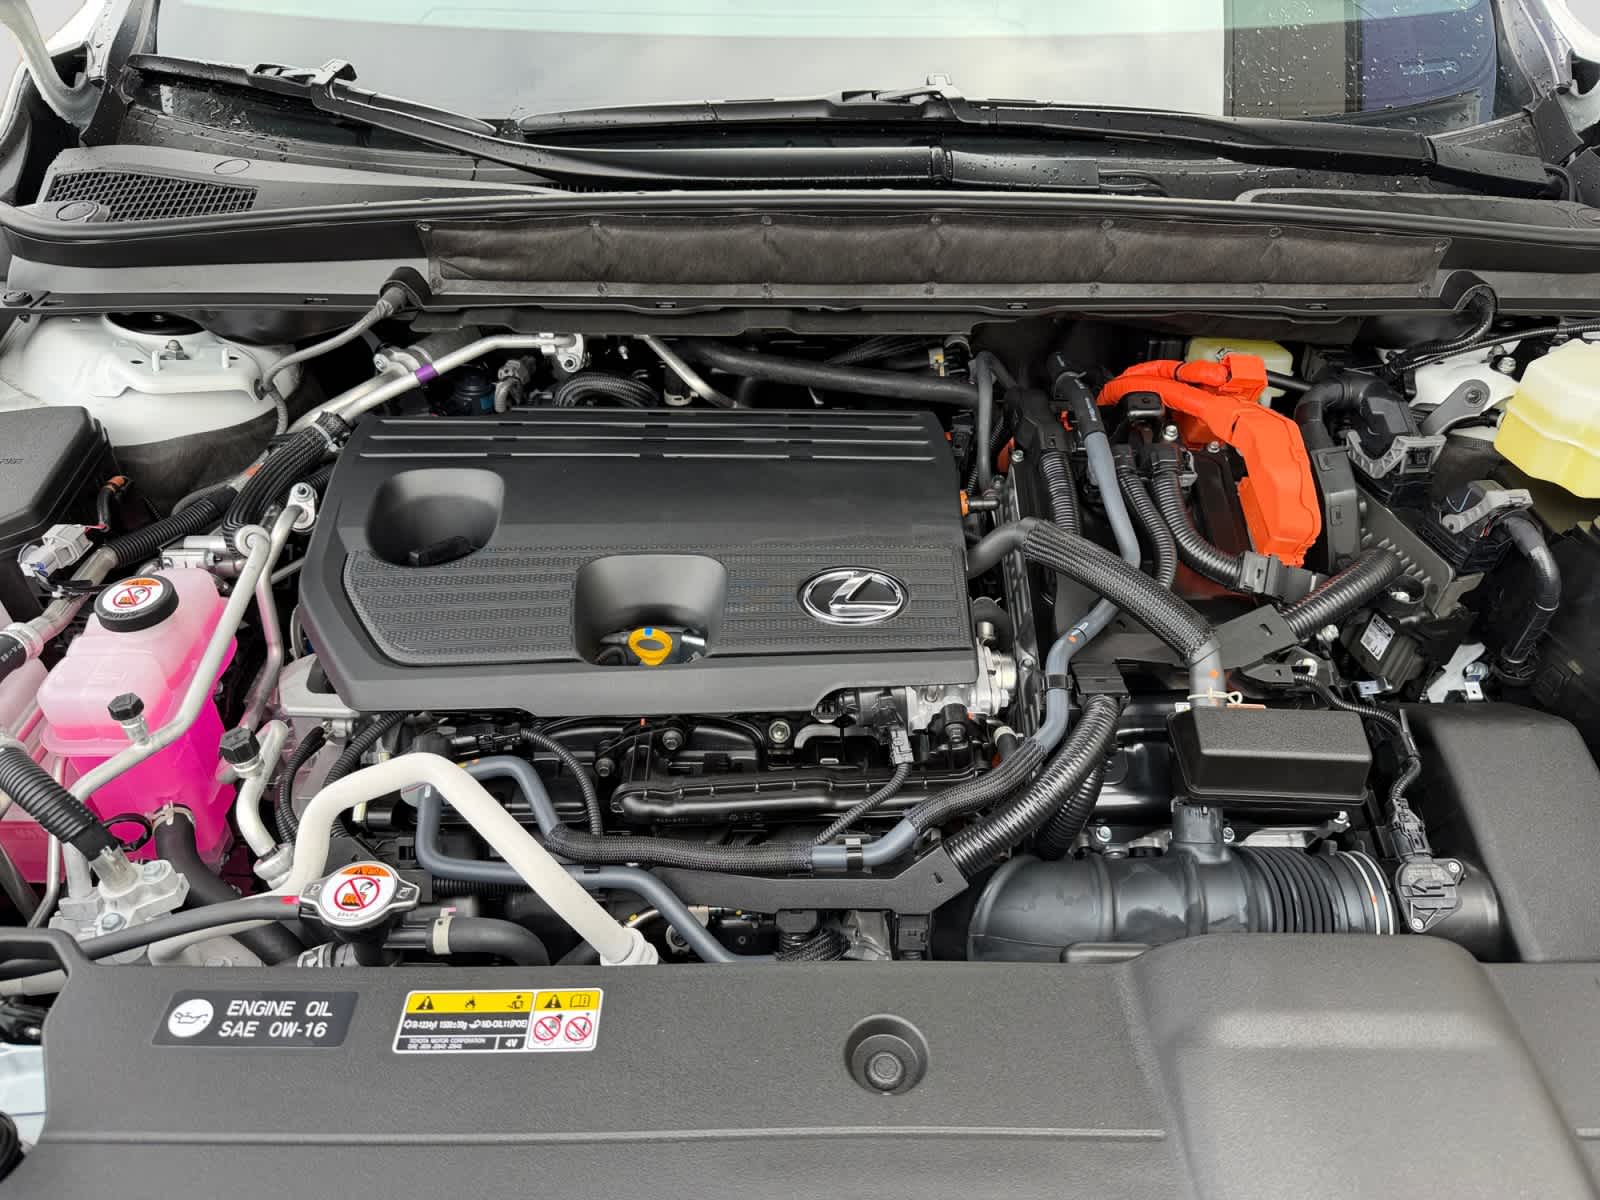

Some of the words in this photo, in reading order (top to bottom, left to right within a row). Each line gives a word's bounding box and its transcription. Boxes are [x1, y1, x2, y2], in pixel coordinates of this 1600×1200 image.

[225, 999, 297, 1017] ENGINE
[305, 1000, 333, 1017] OIL
[218, 1020, 260, 1038] SAE
[268, 1021, 329, 1038] 0W-16
